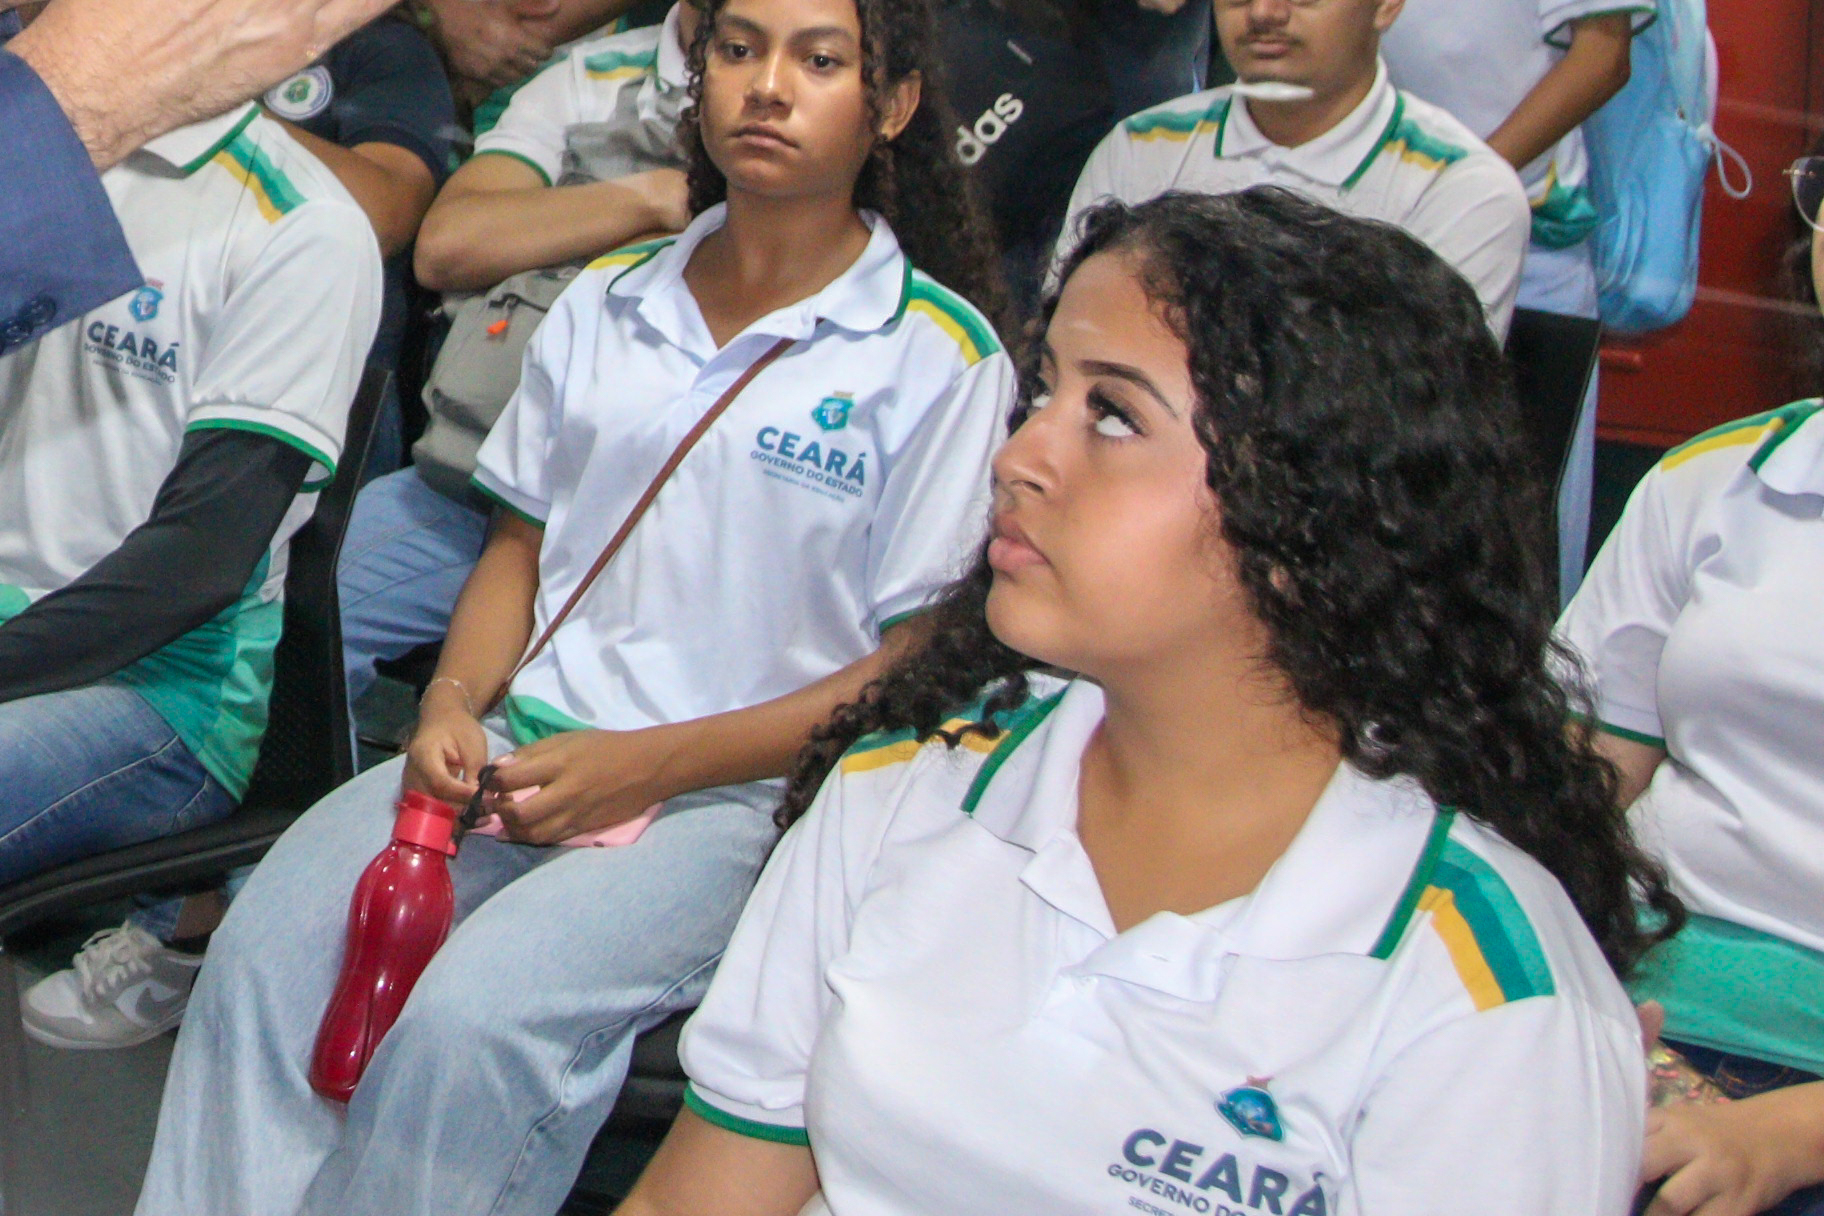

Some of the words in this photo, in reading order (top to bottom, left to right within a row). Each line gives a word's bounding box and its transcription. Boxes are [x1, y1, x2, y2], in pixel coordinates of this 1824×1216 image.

[86, 320, 180, 373] CEARÁ
[749, 450, 805, 475] GOVERNO
[806, 468, 824, 482] DO
[825, 475, 864, 498] ESTADO
[756, 425, 867, 487] CEARÁ
[1107, 1163, 1210, 1214] GOVERNO
[1122, 1128, 1326, 1216] CEARÁ
